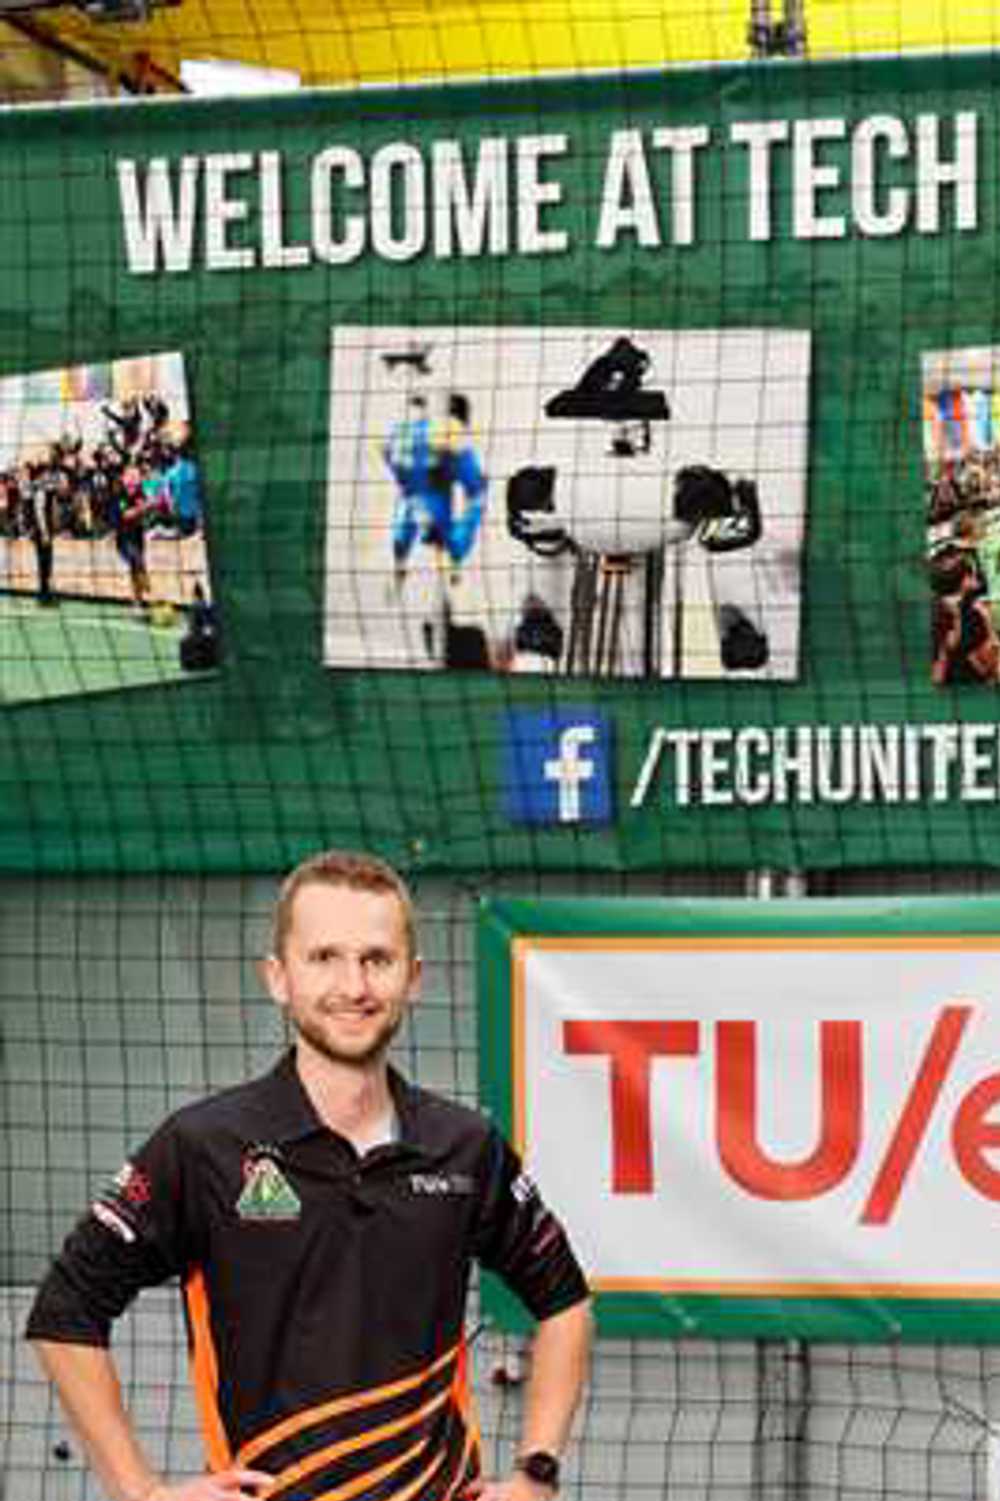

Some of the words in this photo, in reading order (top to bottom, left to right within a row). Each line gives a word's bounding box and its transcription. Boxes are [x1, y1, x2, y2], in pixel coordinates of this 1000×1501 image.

[117, 133, 568, 275] WELCOME
[597, 125, 710, 250] AT
[731, 111, 979, 243] TECH
